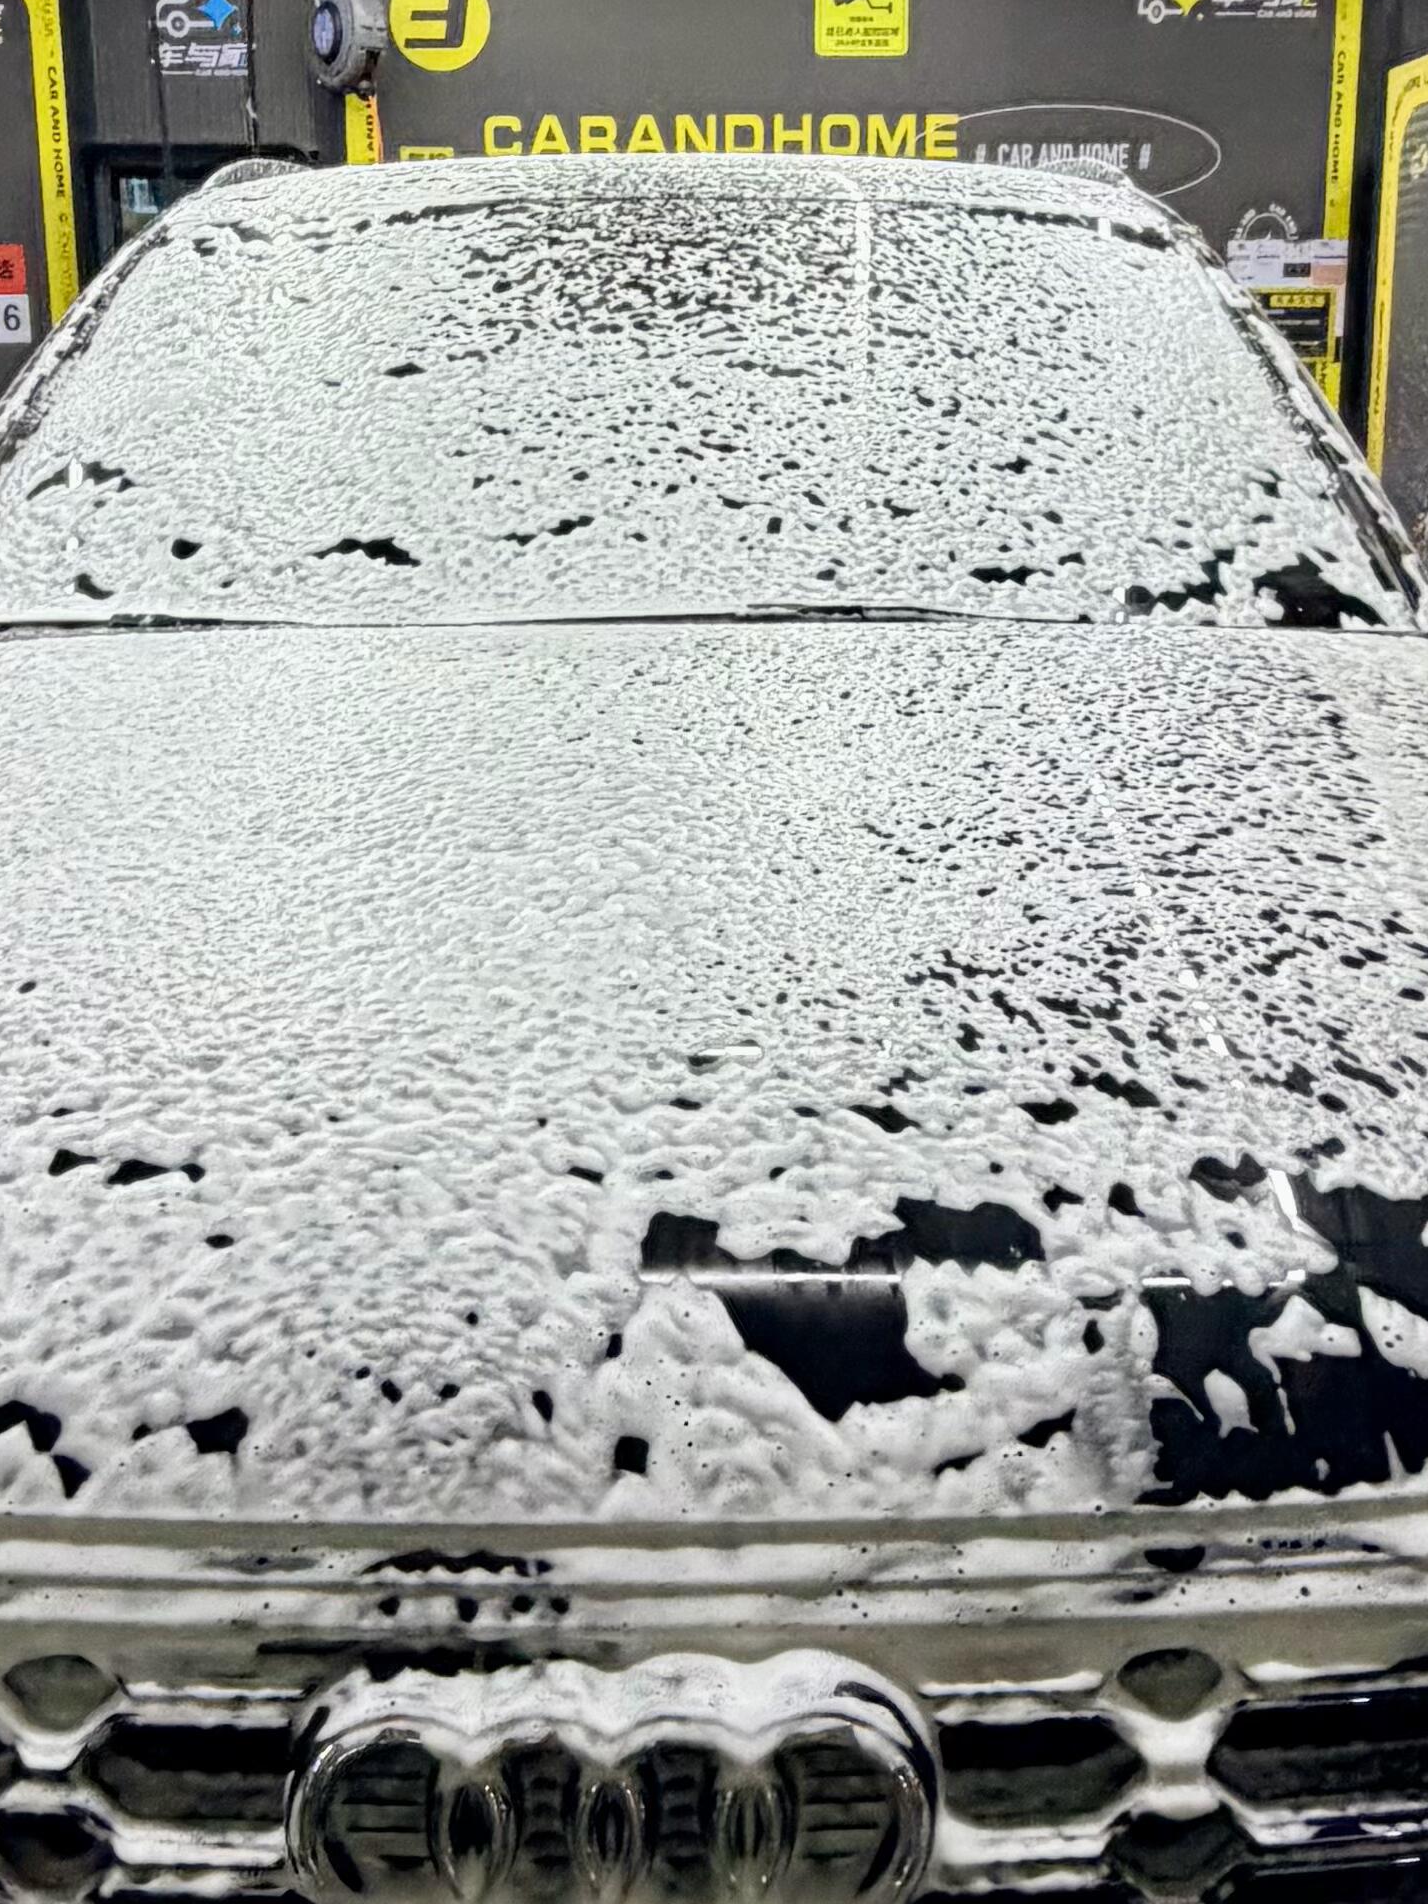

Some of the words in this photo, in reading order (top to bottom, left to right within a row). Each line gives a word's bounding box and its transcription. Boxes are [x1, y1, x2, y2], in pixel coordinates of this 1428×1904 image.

[48, 66, 59, 100] CAR
[1337, 49, 1347, 85] CAR
[50, 106, 62, 141] AND
[53, 147, 67, 198] HOME
[998, 143, 1033, 168] CAR
